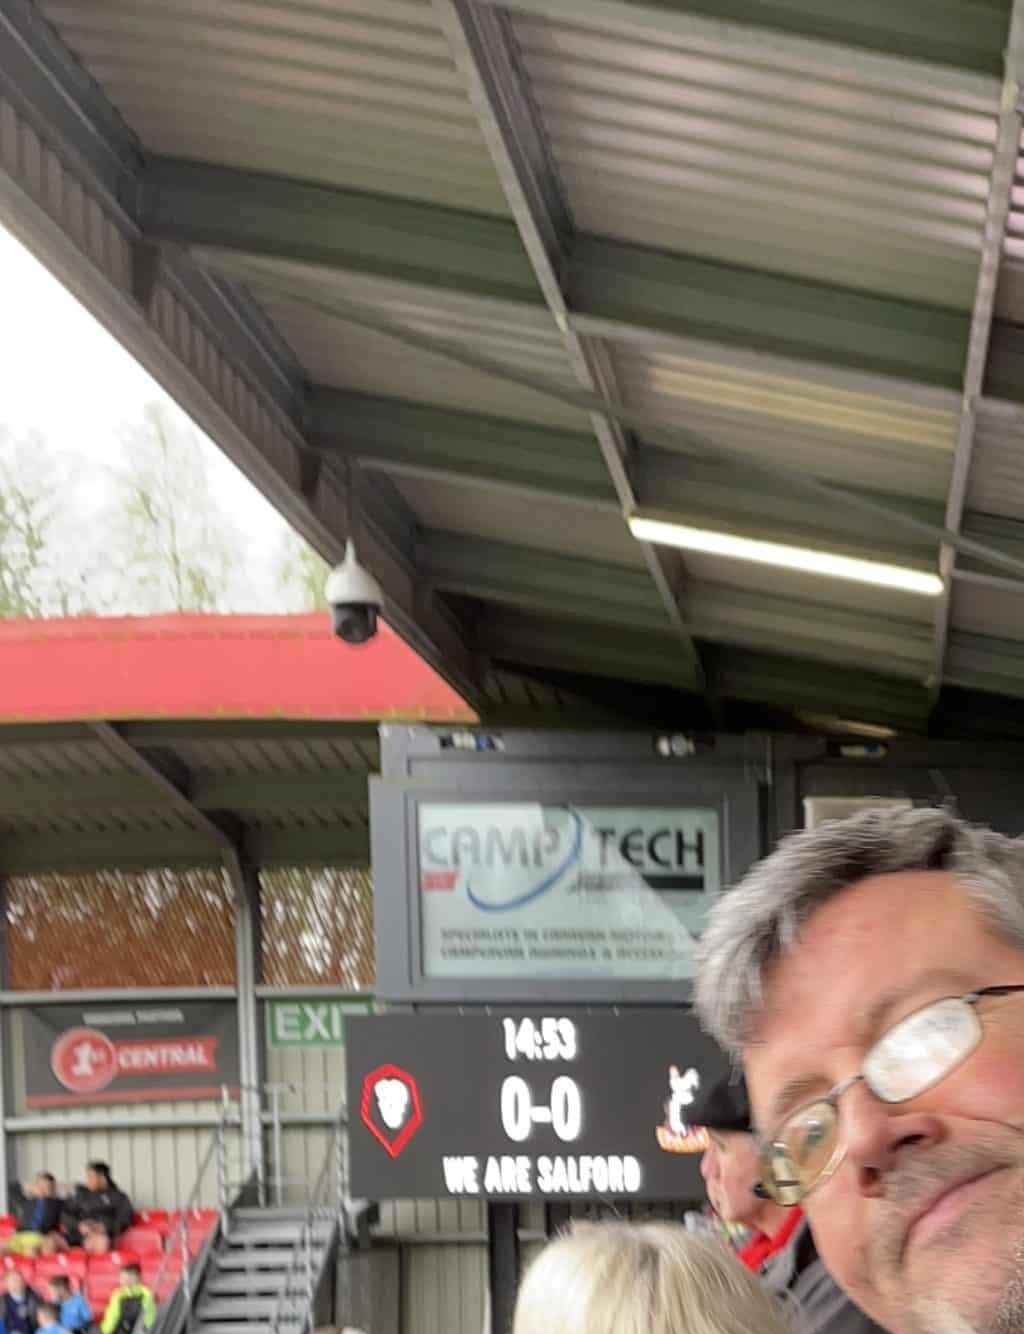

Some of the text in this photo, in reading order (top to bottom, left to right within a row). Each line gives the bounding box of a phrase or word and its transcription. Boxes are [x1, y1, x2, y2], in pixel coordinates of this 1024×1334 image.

[595, 828, 705, 867] TECH
[119, 1039, 208, 1070] CENTRAL
[503, 1017, 577, 1061] 14:53
[500, 1075, 582, 1142] 0-0
[442, 1156, 641, 1194] WE ARE SALFORD
